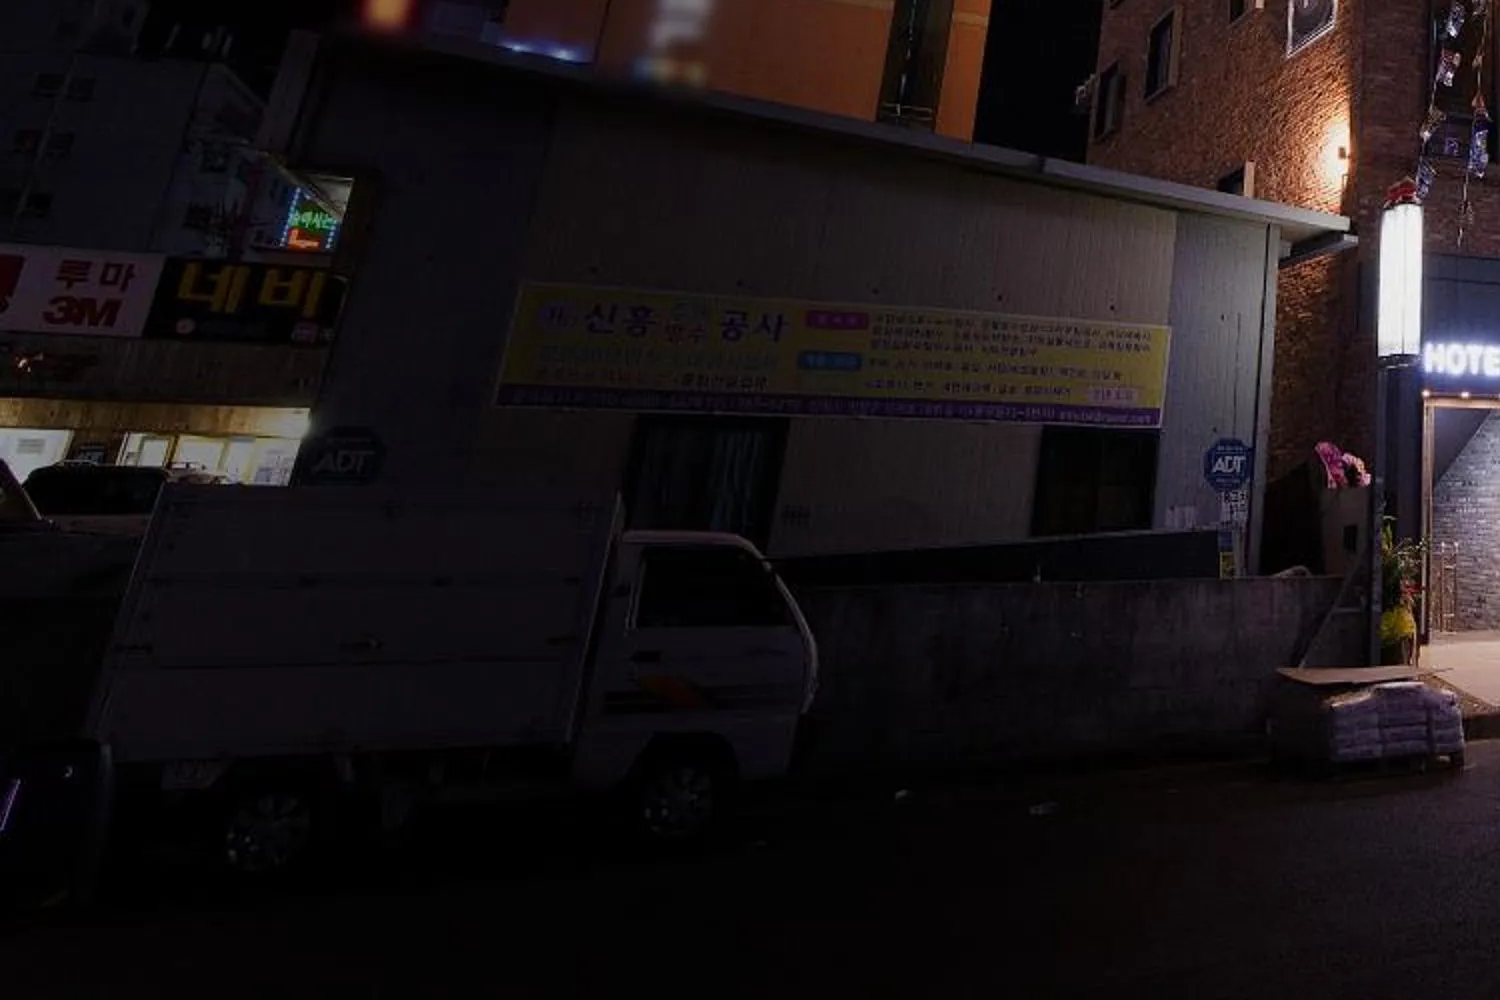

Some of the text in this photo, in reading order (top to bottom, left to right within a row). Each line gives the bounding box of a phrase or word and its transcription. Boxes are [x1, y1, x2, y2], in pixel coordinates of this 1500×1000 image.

[57, 260, 329, 319] 루마 네비
[42, 296, 121, 327] 3M
[315, 447, 378, 475] ADT
[1211, 454, 1247, 474] ADT
